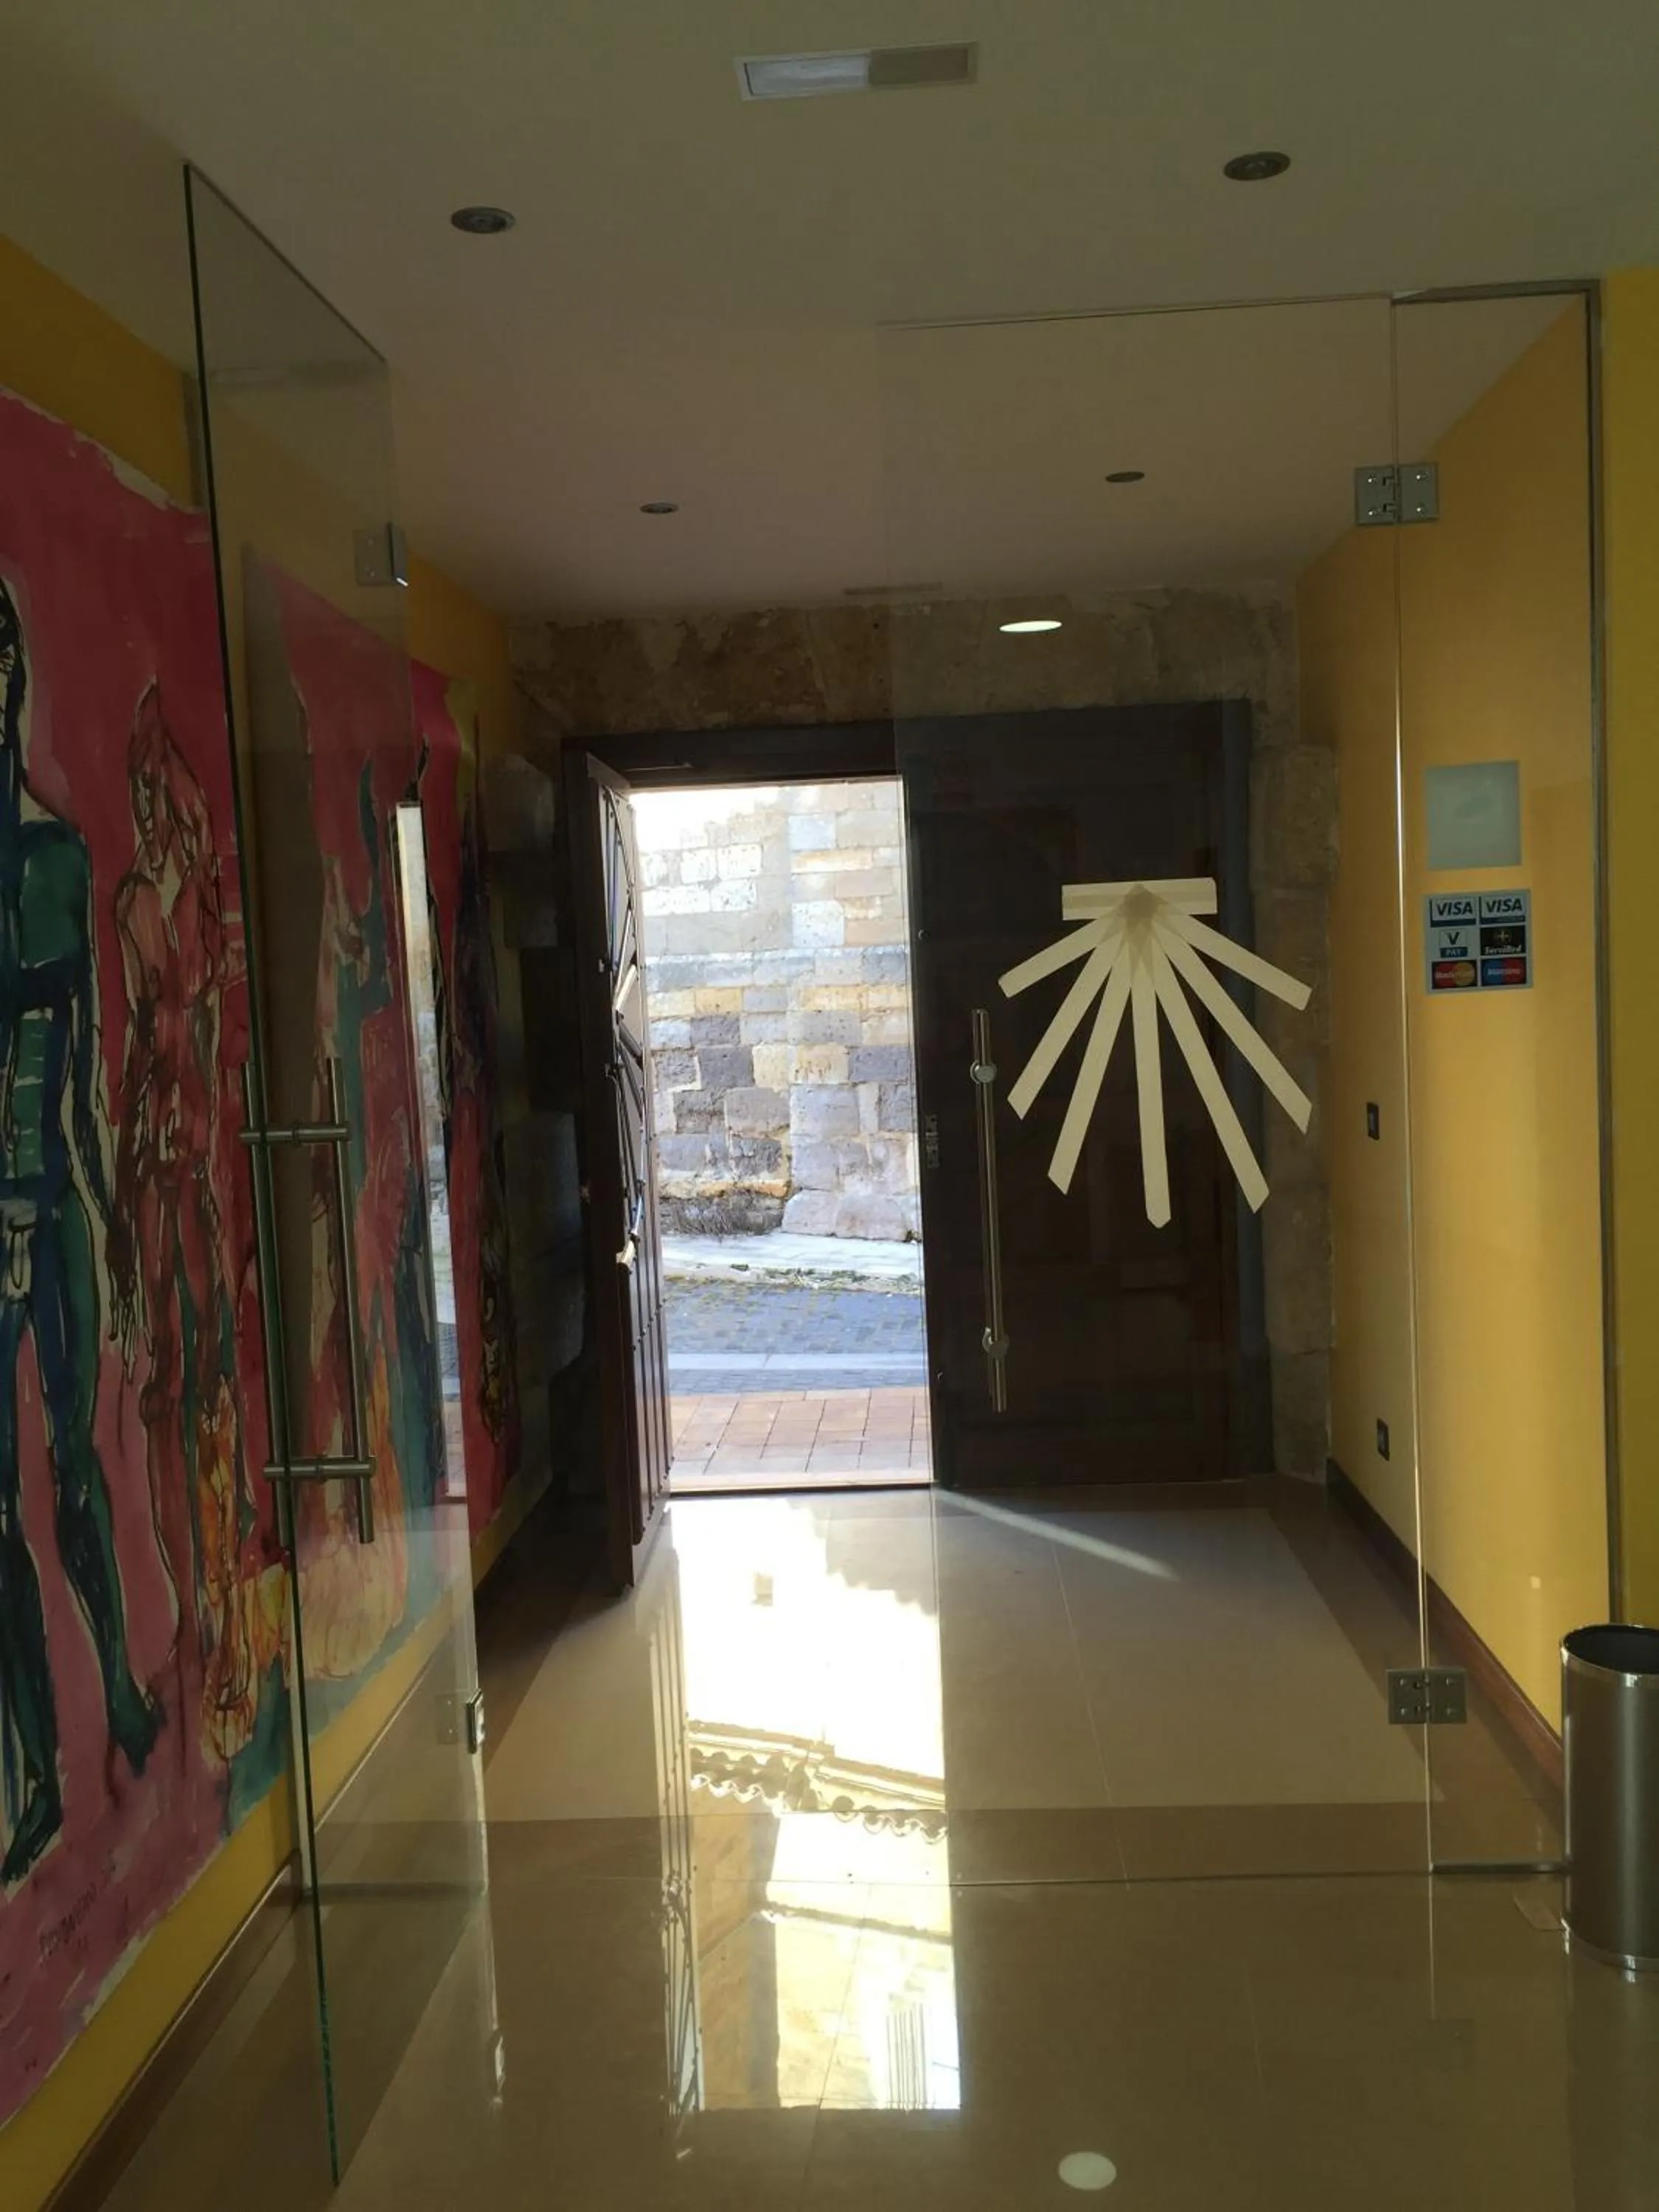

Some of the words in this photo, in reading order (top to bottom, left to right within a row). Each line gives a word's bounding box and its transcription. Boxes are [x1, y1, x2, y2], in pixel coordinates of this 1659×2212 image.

[1436, 901, 1473, 916] VISA
[1485, 898, 1523, 913] VISA
[1447, 931, 1460, 945] V
